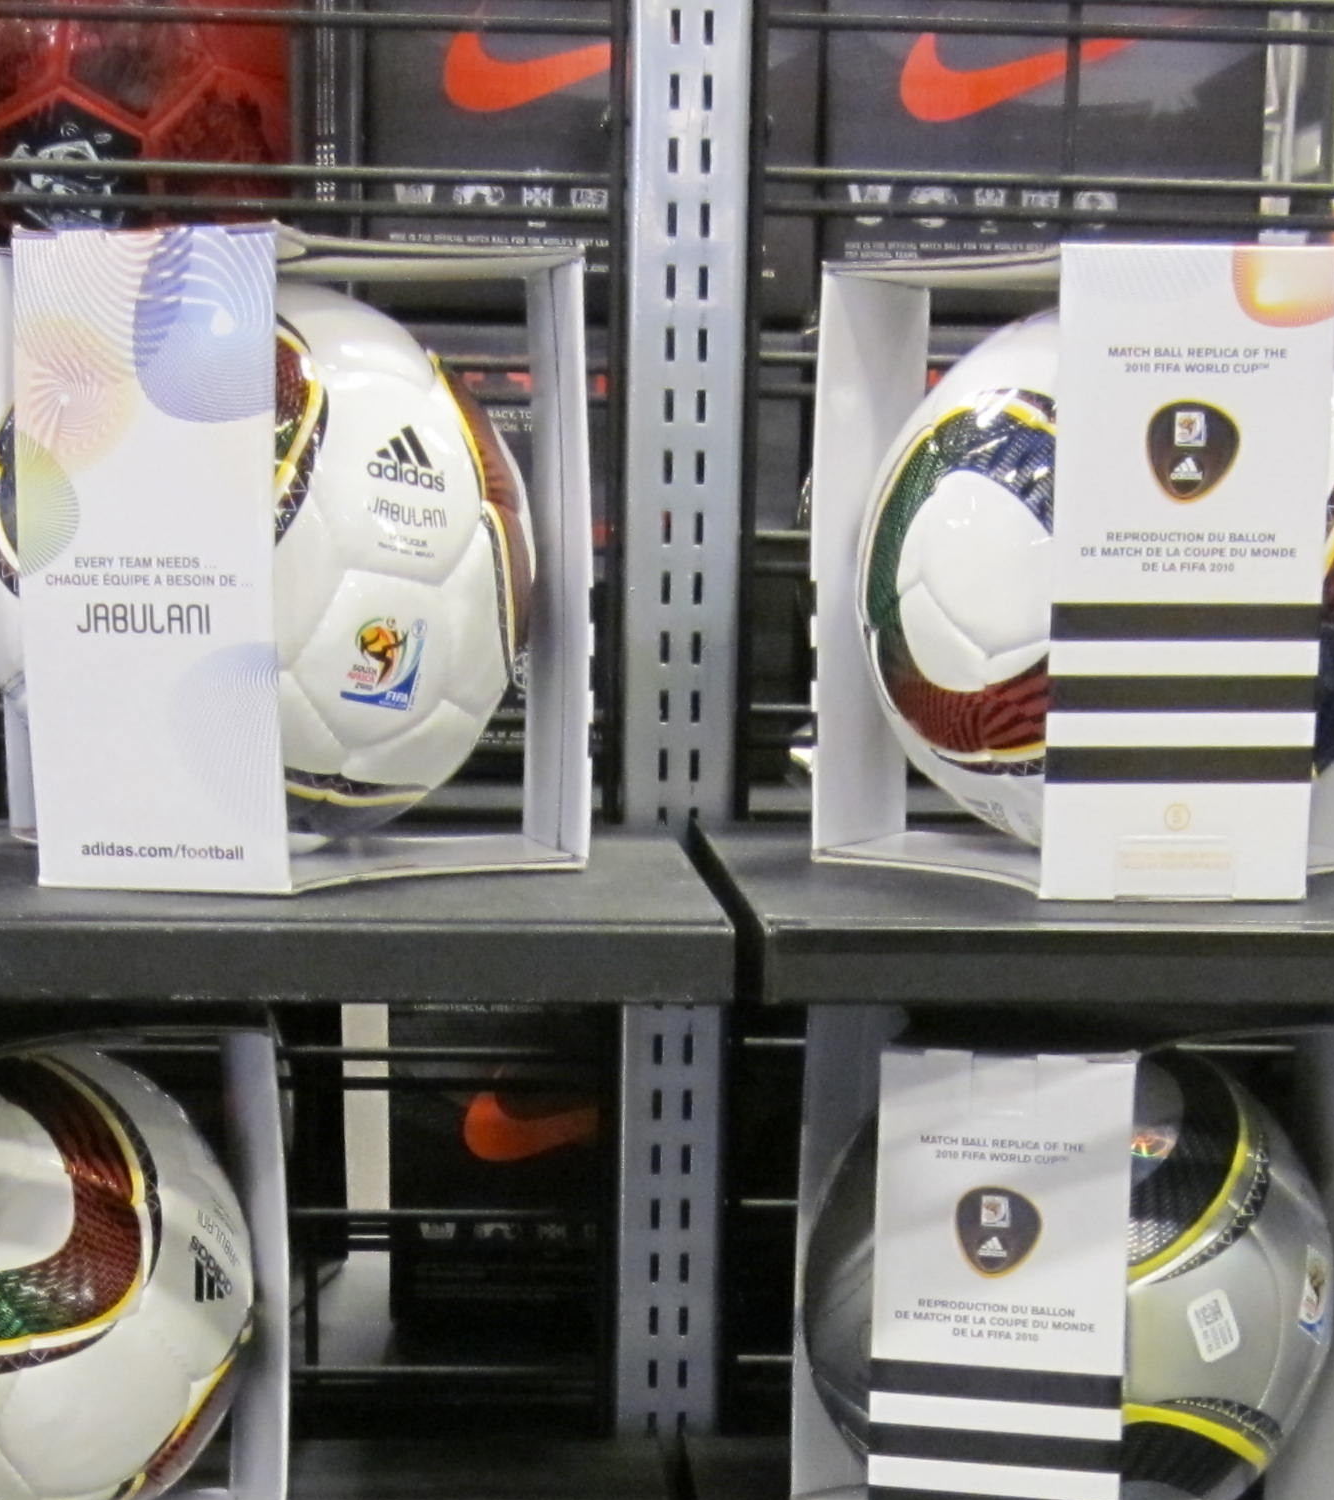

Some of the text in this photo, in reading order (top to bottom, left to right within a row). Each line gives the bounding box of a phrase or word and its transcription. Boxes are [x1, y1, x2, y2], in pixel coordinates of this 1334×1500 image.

[1107, 346, 1287, 359] MATCH BALL REPLICA OF THE
[1124, 361, 1151, 373] 2010
[1153, 361, 1181, 373] FIFA
[1183, 362, 1230, 374] WORLD
[366, 460, 446, 493] adidas
[367, 496, 448, 528] JABULANI
[1105, 531, 1276, 543] REPRODUCTION DU BALLON
[1079, 545, 1297, 558] DE MATCH DE LA COUPE DU MONDE
[73, 555, 200, 569] EVERY TEAM NEEDS
[1140, 561, 1235, 573] DE LA FIFA 2010
[44, 573, 99, 586] CHAQUE
[153, 574, 162, 585] A
[165, 573, 215, 587] BESOIN
[218, 573, 237, 587] DE
[75, 602, 211, 635] JABULANI
[80, 841, 245, 859] adidas.com/football
[919, 1134, 1086, 1154] MATCH BALL REPLICA OF THE
[960, 1149, 987, 1161] FIFA
[988, 1151, 1032, 1164] WORLD
[917, 1297, 1075, 1318] REPRODUCTION DU BALLON
